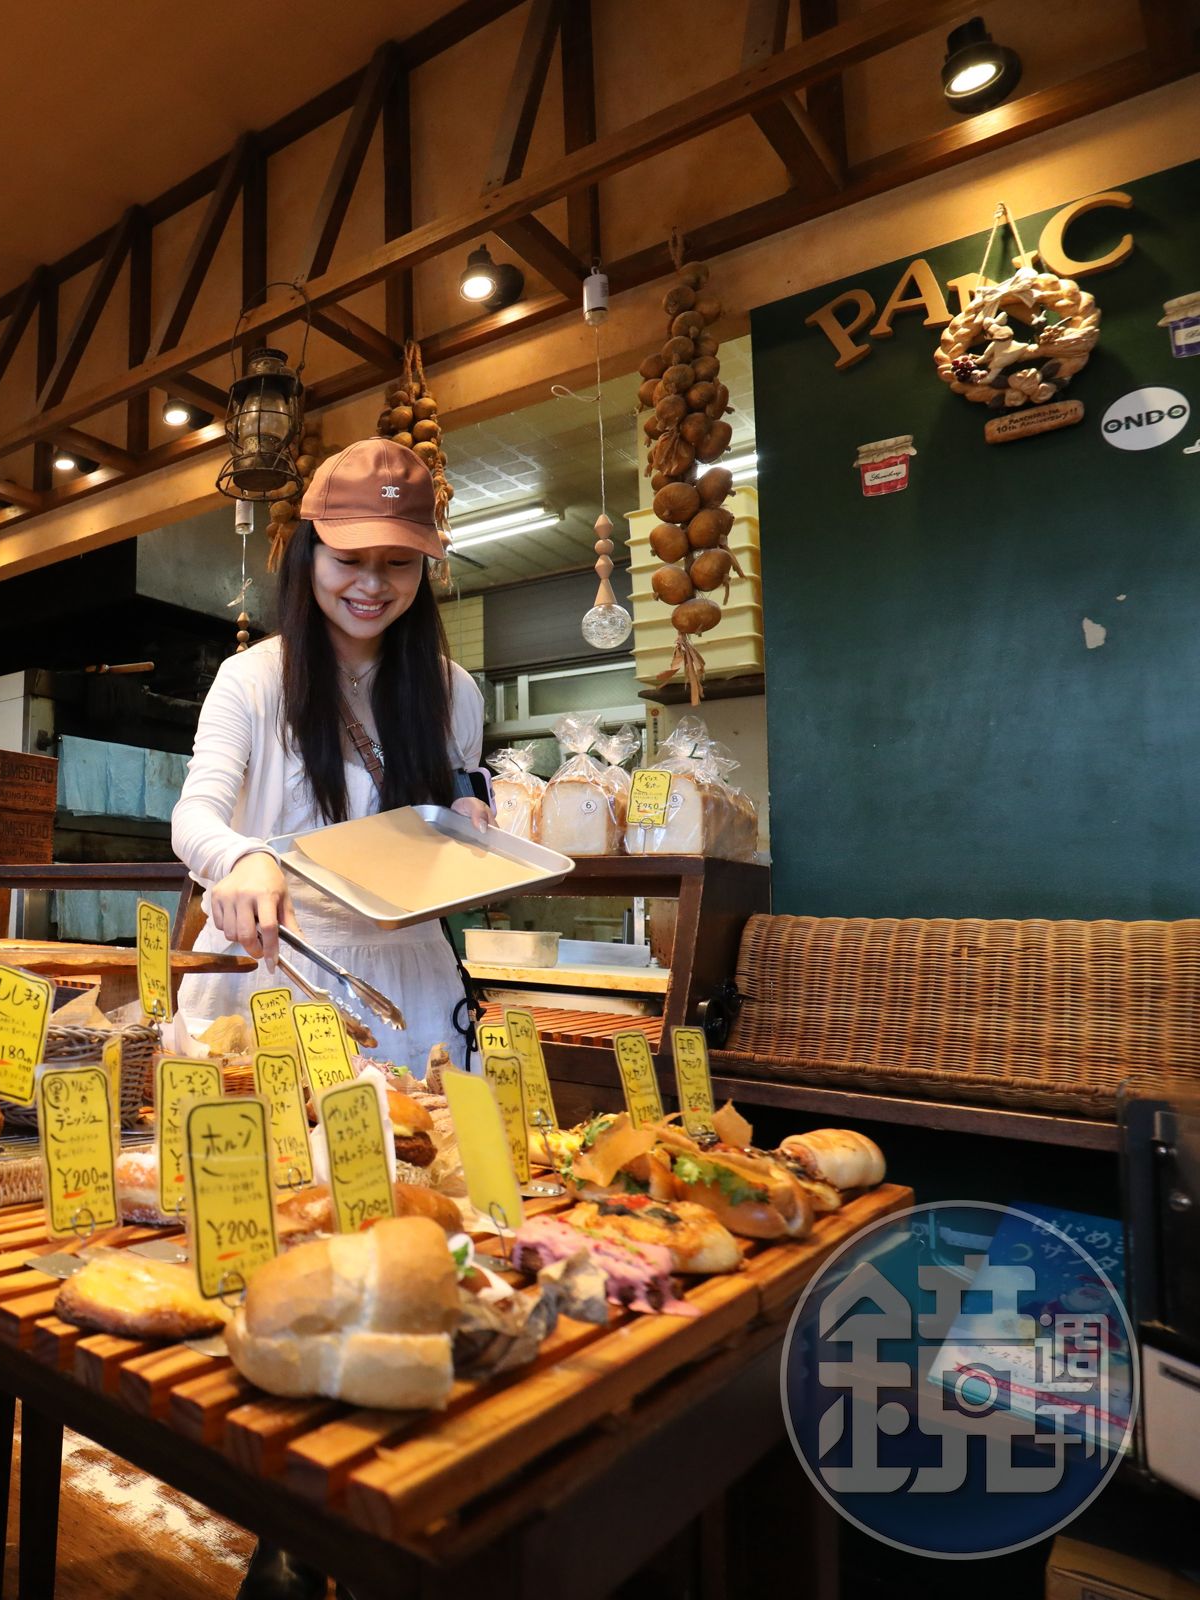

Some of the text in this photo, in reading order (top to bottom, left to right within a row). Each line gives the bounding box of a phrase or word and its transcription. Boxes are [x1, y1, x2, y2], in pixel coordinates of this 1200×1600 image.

[1103, 404, 1187, 434] ONDO
[507, 799, 513, 808] 5
[585, 801, 592, 809] 6
[206, 1219, 258, 1249] ¥200
